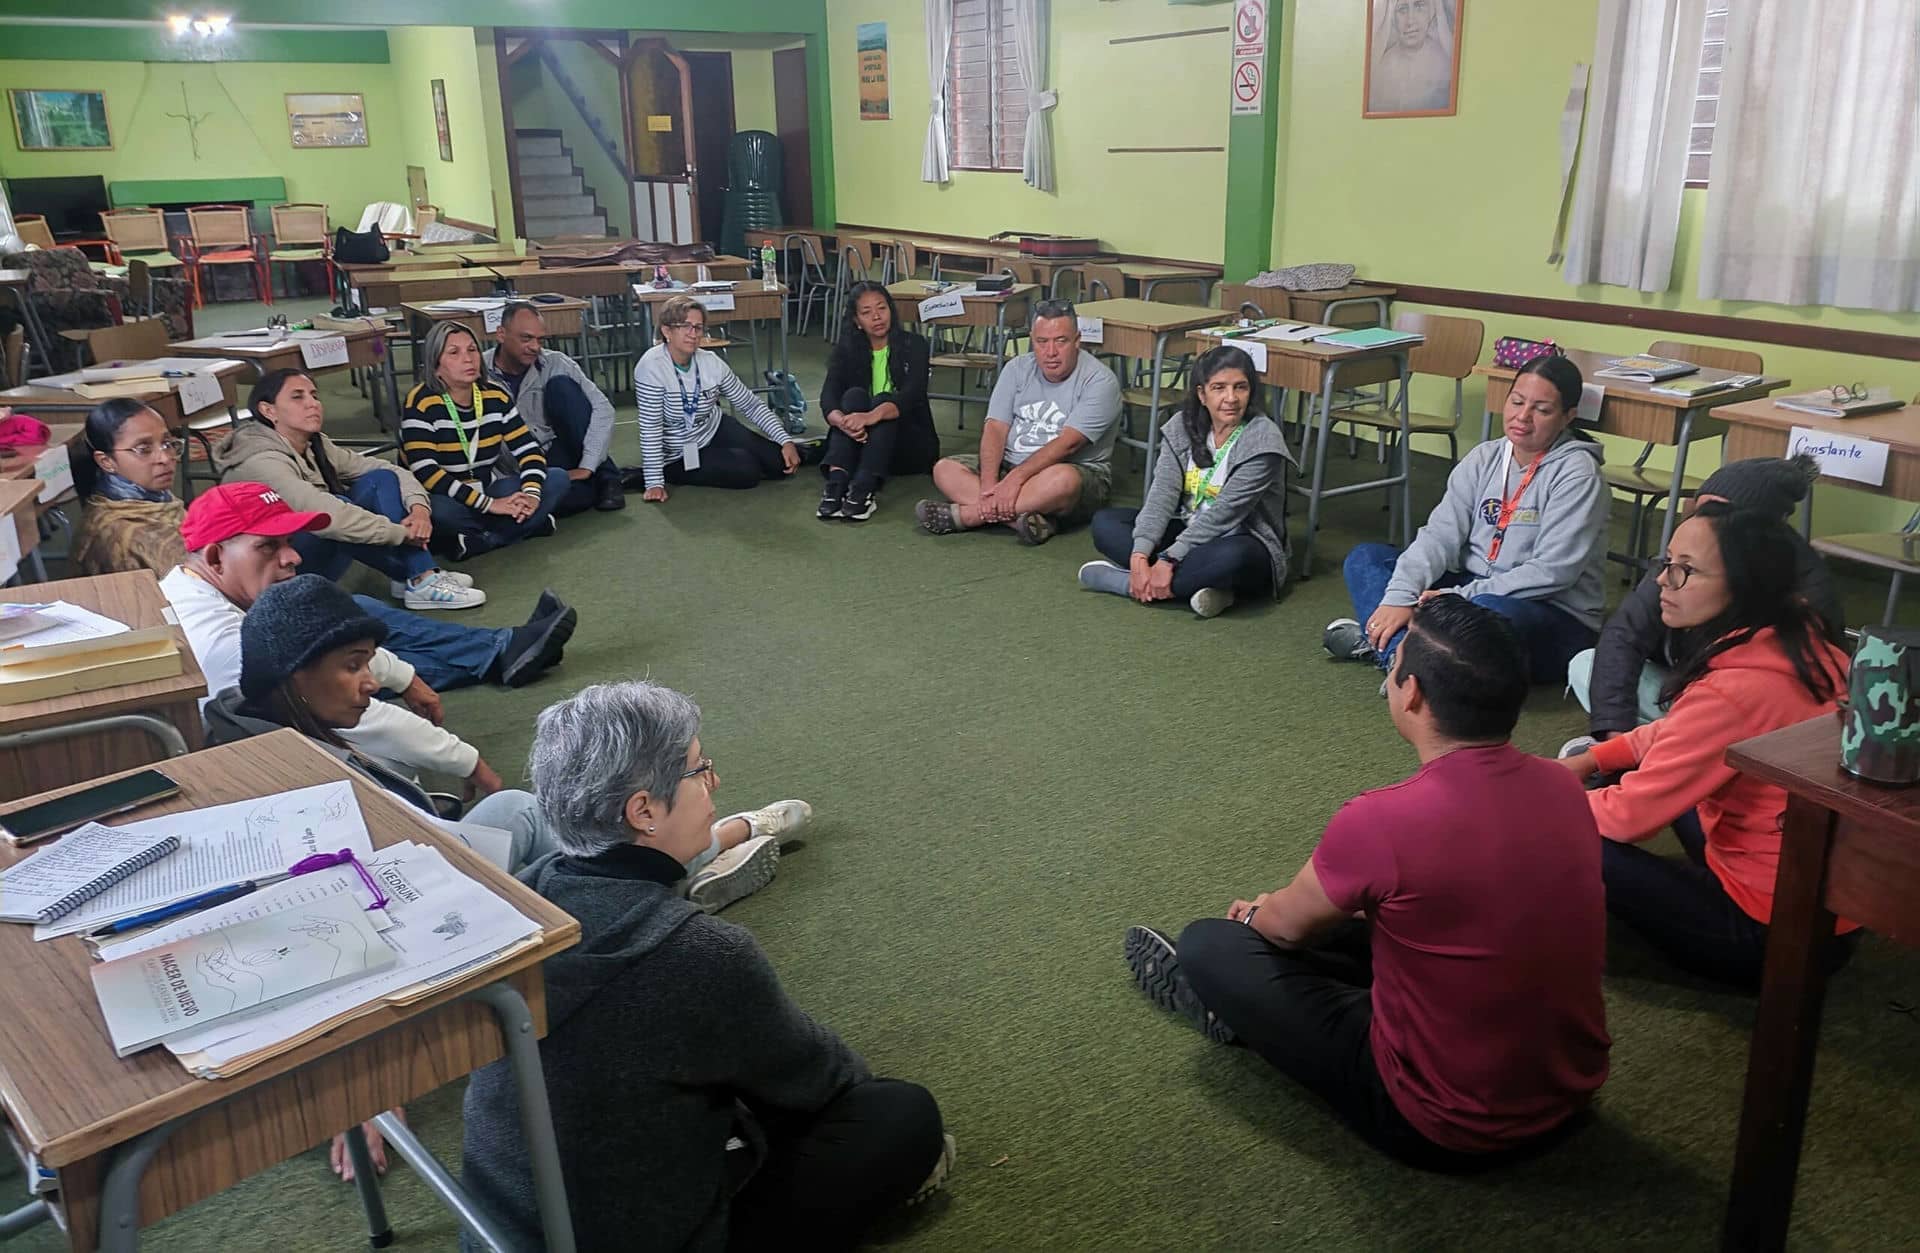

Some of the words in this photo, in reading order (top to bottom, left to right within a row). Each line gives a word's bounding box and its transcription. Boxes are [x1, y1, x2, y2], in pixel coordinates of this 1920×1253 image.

[1795, 435, 1863, 458] Constante
[381, 868, 419, 903] VEDRUNA
[170, 979, 188, 992] DE
